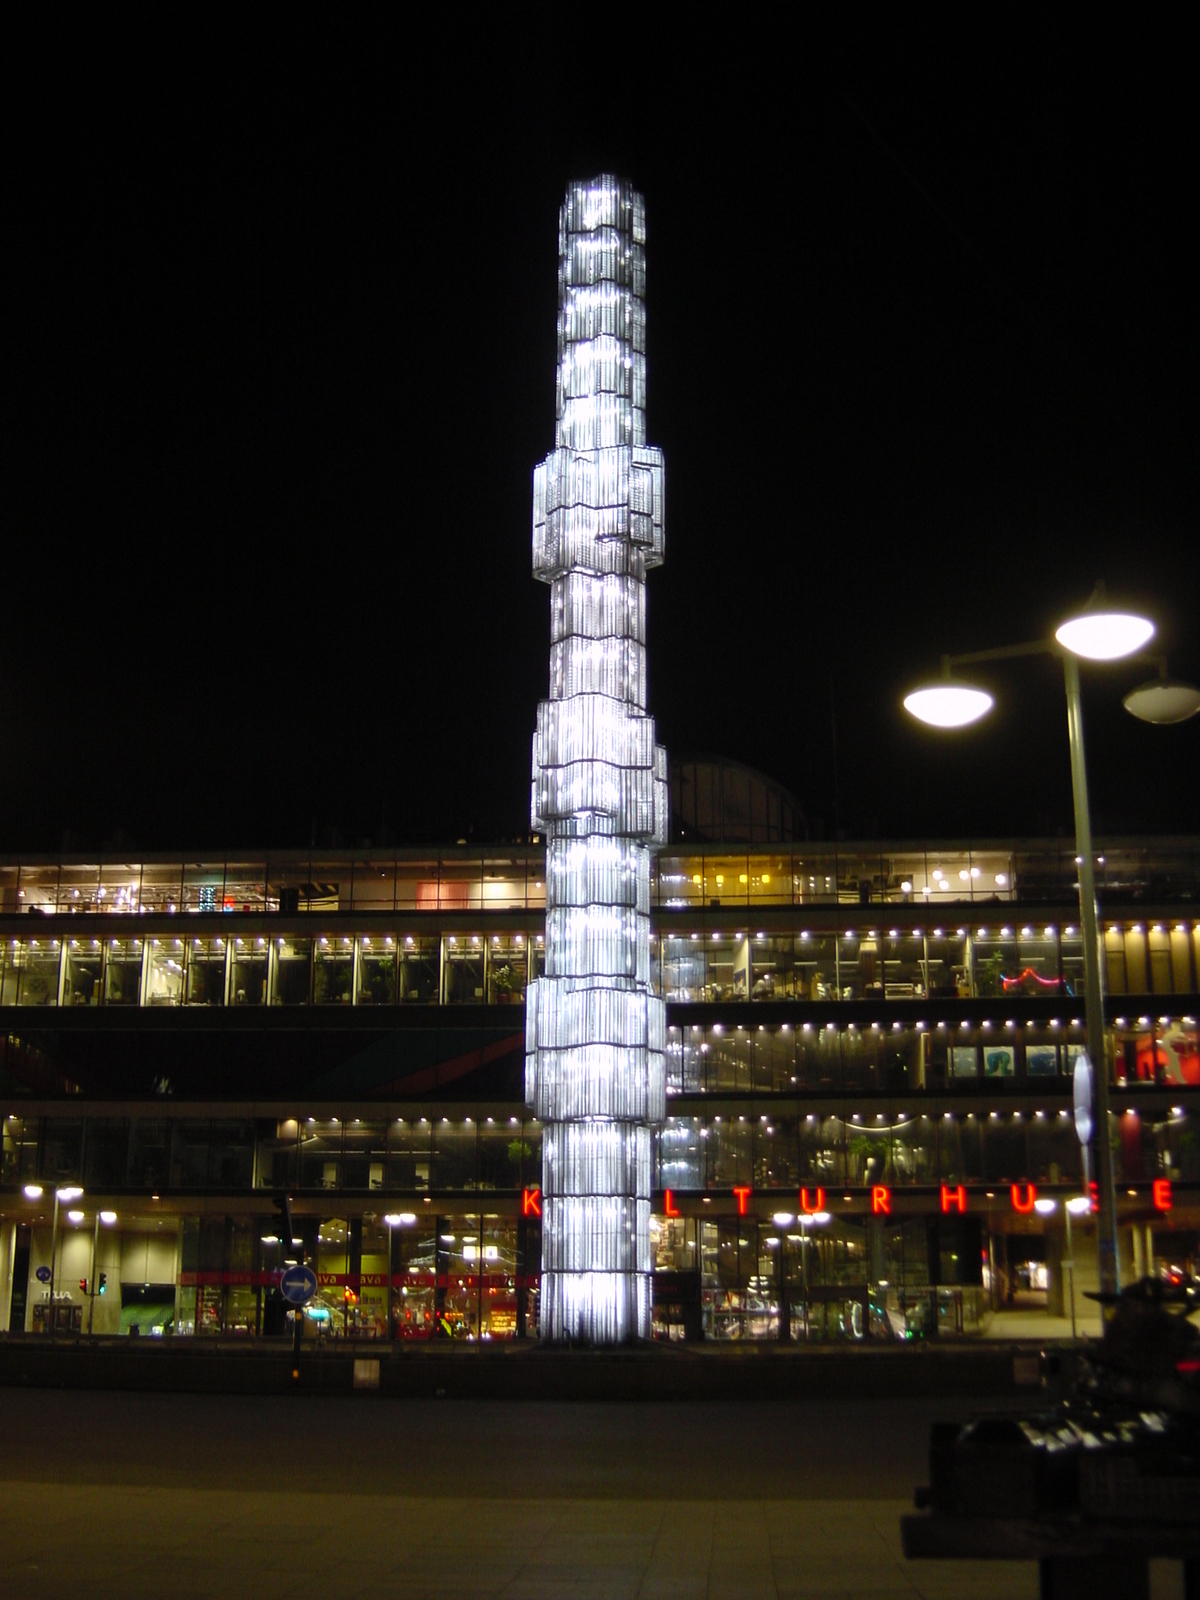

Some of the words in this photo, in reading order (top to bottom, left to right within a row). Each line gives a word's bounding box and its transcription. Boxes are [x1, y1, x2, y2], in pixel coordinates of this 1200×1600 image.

[522, 1177, 1173, 1217] KLTURHUE
[317, 1275, 336, 1285] ava
[360, 1275, 381, 1285] ava
